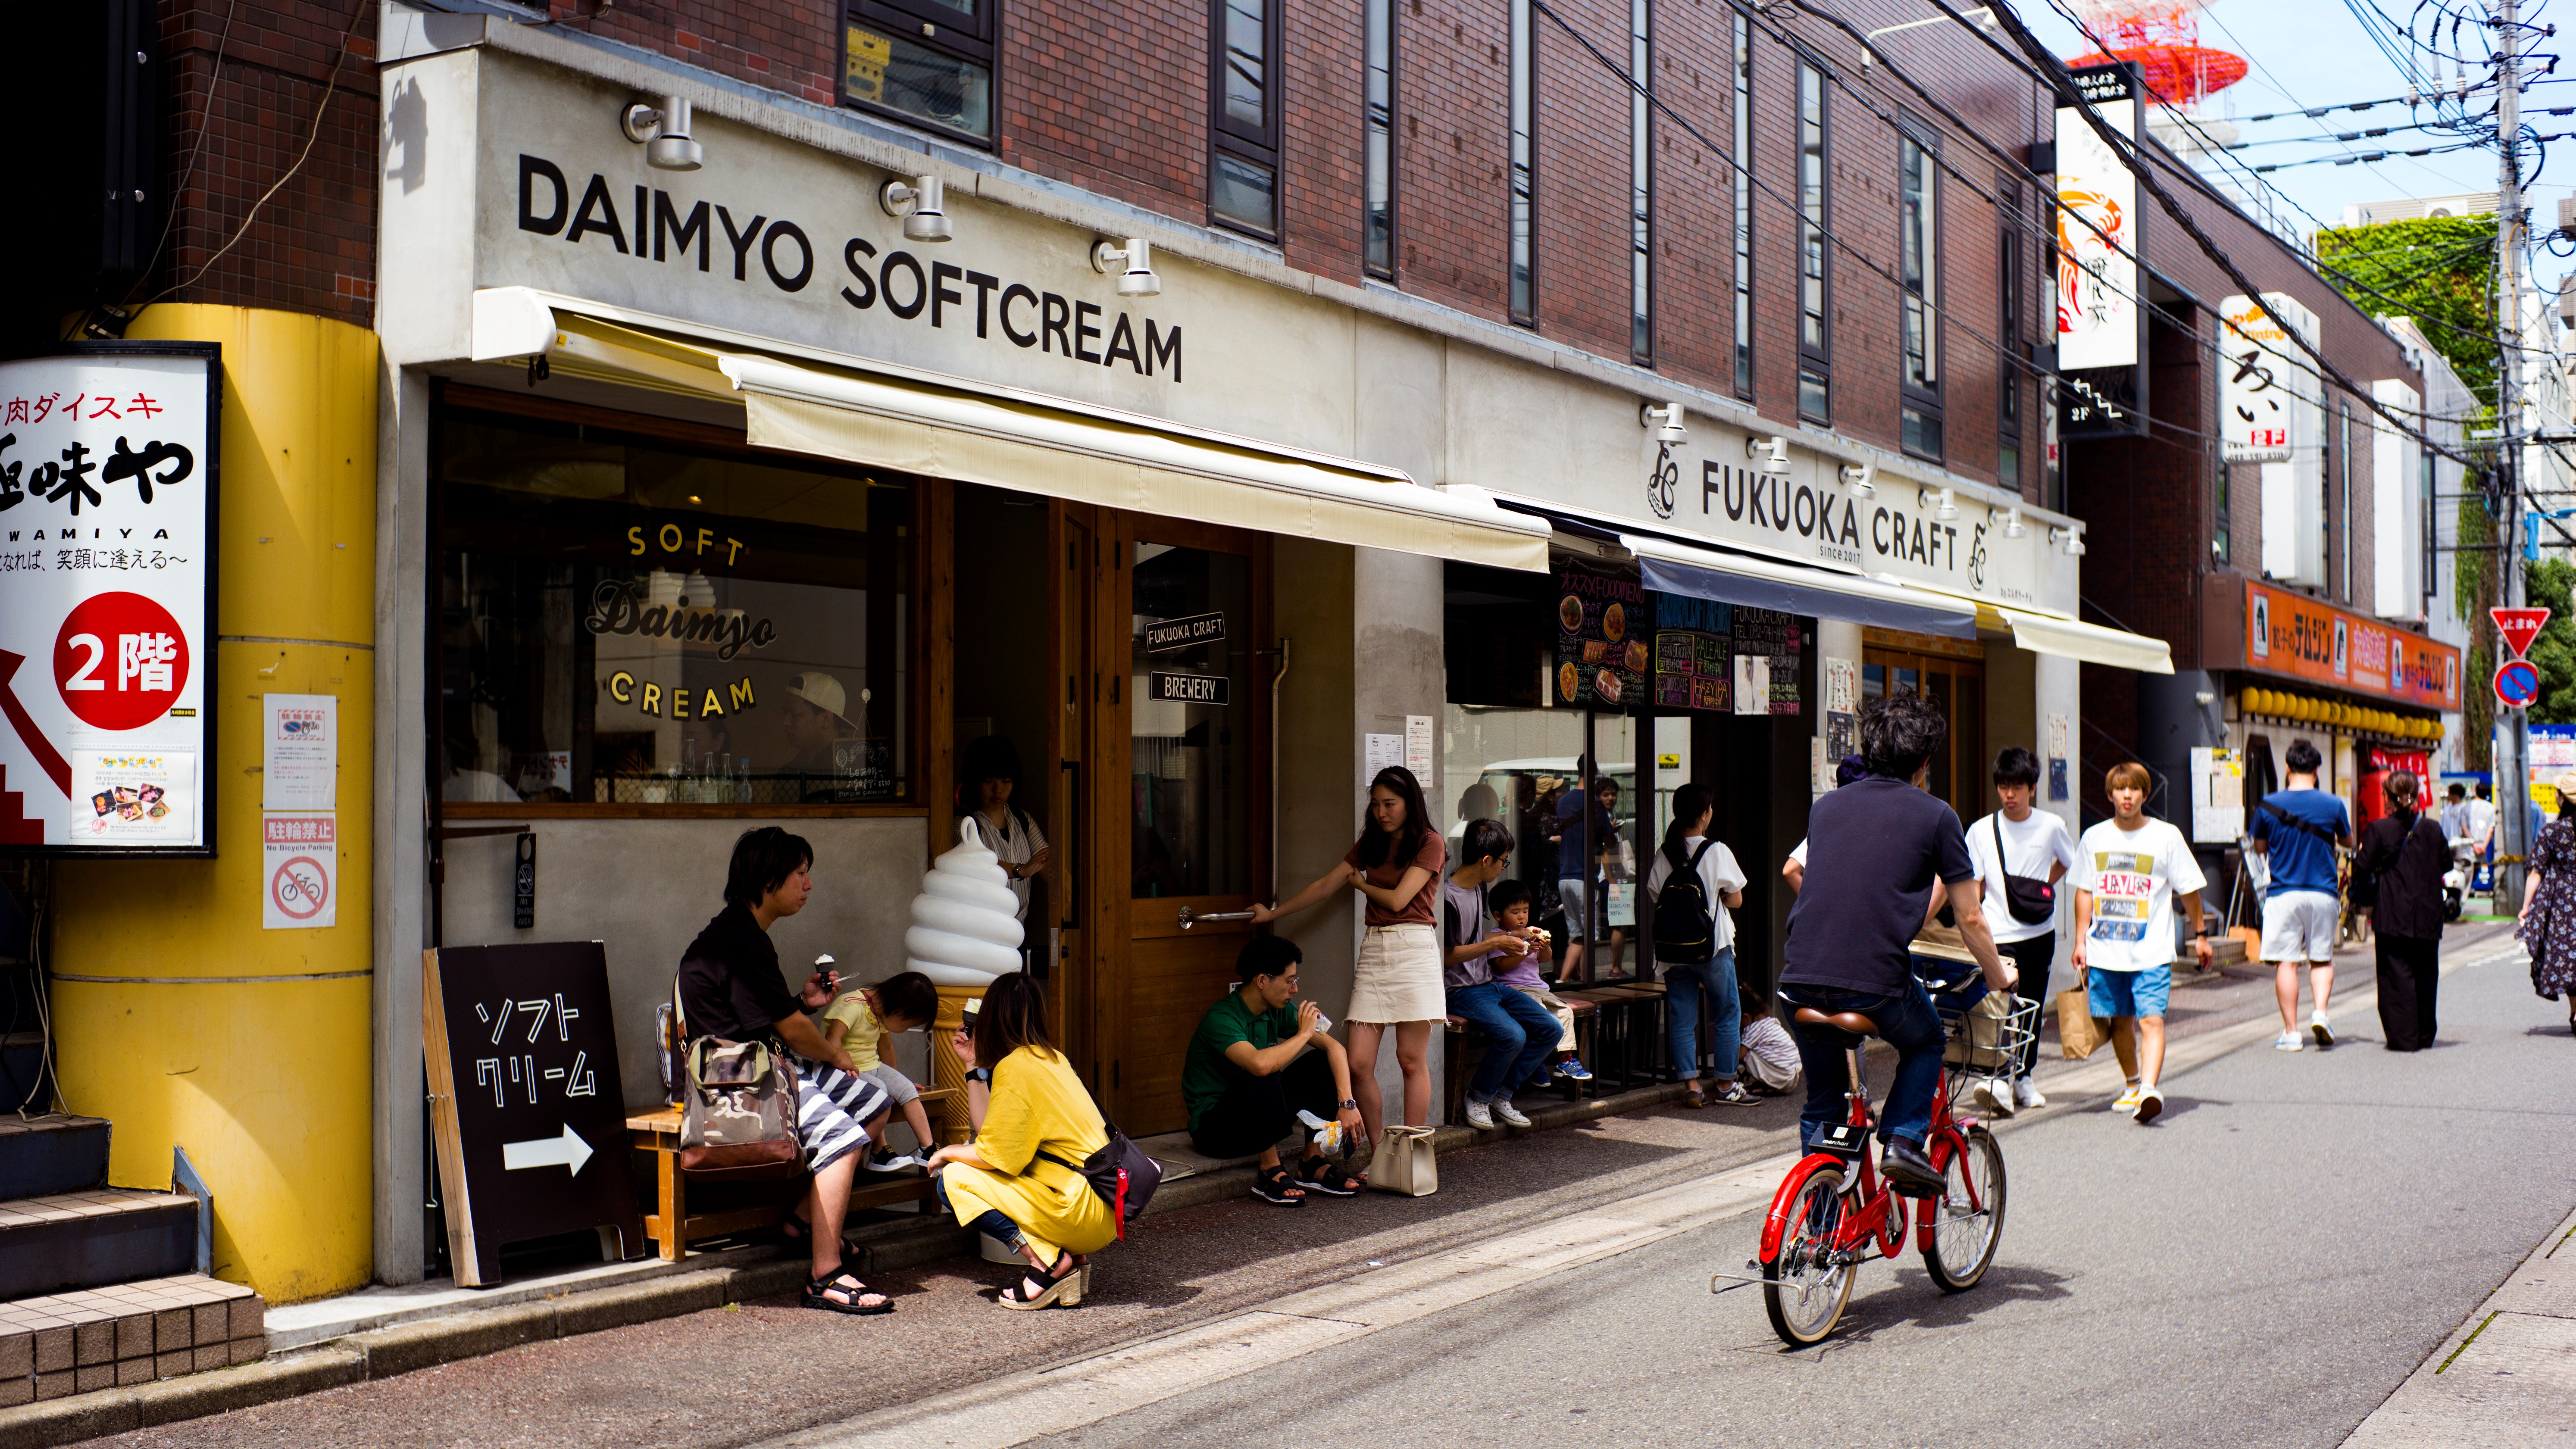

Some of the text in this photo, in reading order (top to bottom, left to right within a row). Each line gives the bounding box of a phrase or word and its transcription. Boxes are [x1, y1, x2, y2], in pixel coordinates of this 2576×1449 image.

[519, 153, 1182, 384] DAIMYO SOFTCREAM
[0, 393, 163, 426] 肉ダイスキ
[2071, 407, 2090, 421] 2F
[2252, 430, 2283, 446] 2F
[1703, 459, 1957, 571] FUKUOKA CRAFT
[9, 528, 169, 542] WAMIYA
[628, 523, 744, 566] SOFT
[0, 548, 187, 571] なれば、笑顔に逢える～
[1820, 546, 1860, 564] since 2017
[585, 579, 777, 661] Daimyo
[1148, 618, 1222, 645] FUKUOKA CRAFT
[2503, 618, 2538, 630] 止まれ
[66, 632, 177, 691] 2階
[608, 670, 756, 721] CREAM
[1165, 676, 1216, 700] BREWERY
[268, 821, 331, 840] 駐輪禁止
[2096, 874, 2150, 896] ELVIS
[520, 897, 528, 906] NO
[518, 917, 531, 926] AREA
[475, 993, 579, 1045] ソフト
[476, 1050, 596, 1107] クリーム
[1822, 1139, 1849, 1147] merchari
